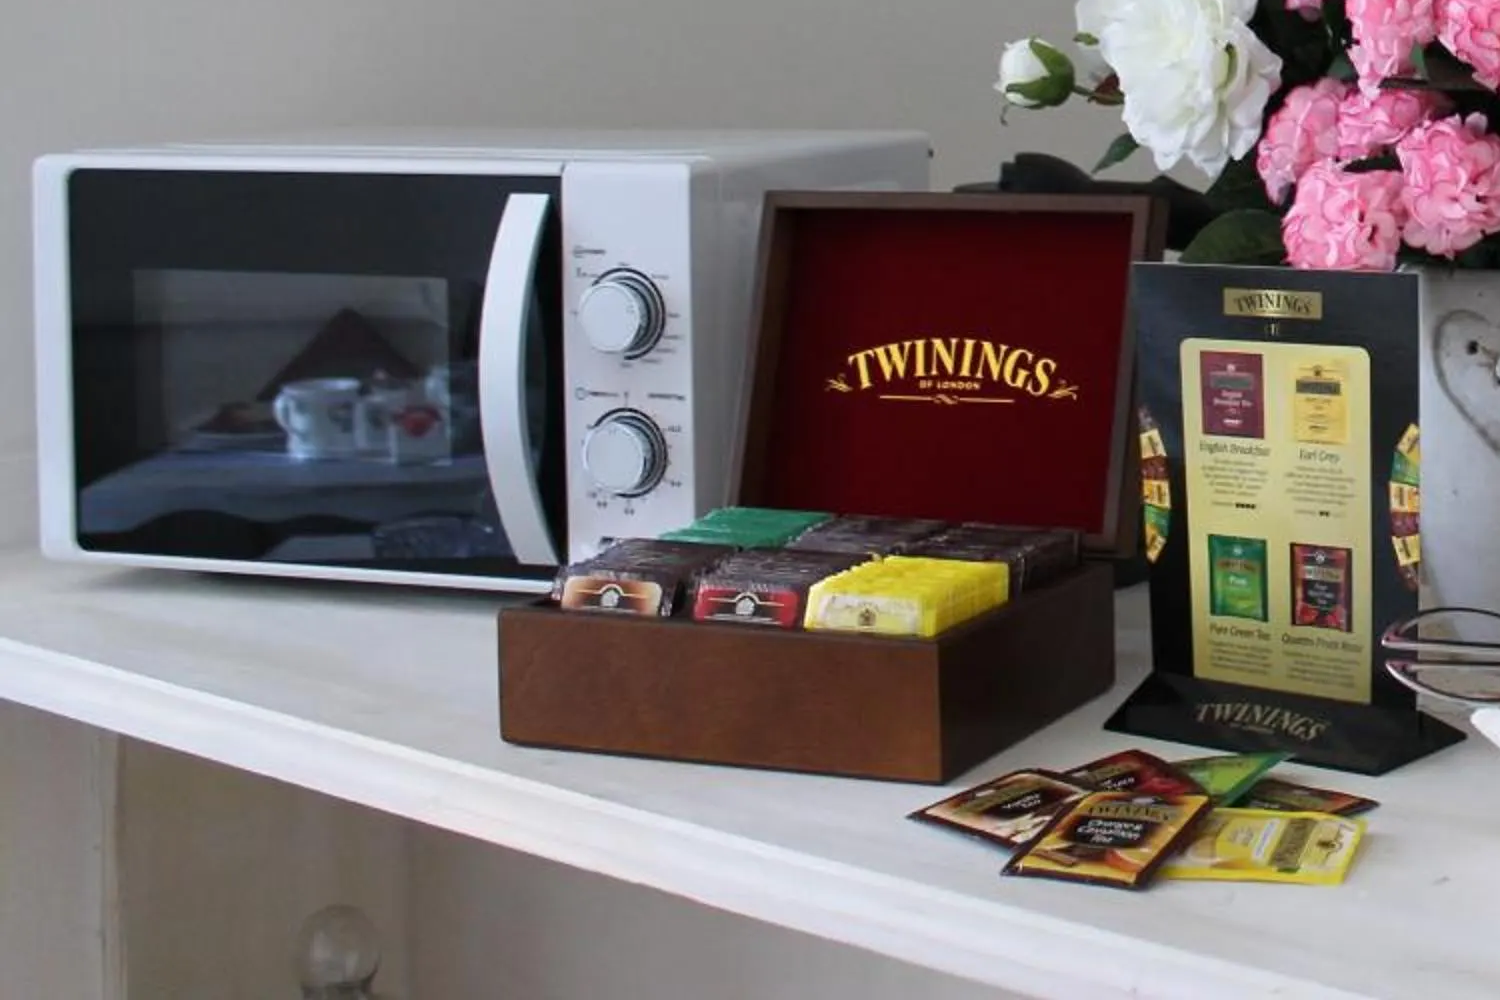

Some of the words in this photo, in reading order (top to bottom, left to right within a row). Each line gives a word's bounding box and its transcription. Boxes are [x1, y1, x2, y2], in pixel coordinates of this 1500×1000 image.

[1233, 292, 1313, 315] TWININGS
[848, 337, 1056, 397] TWININGS
[919, 379, 933, 389] OF
[936, 380, 981, 390] LONDON
[1196, 702, 1330, 740] TWININGS
